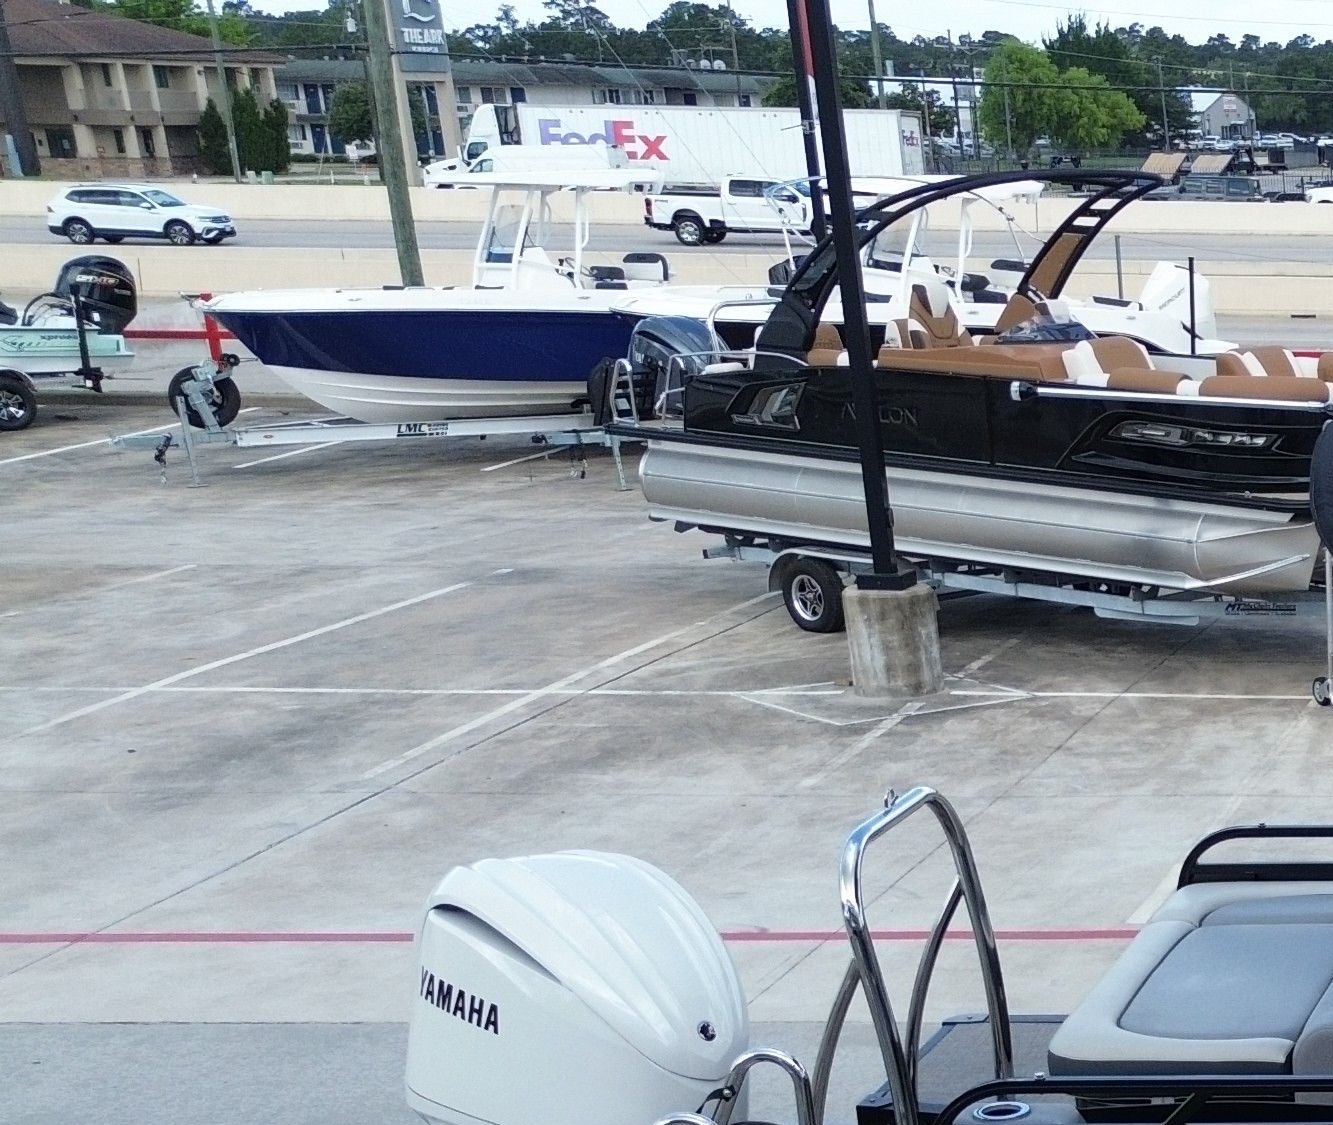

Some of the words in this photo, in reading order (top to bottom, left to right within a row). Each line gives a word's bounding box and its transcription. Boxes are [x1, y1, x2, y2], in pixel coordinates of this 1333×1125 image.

[401, 28, 423, 43] THE
[423, 28, 445, 44] ARK
[841, 402, 919, 427] ALON
[420, 965, 500, 1035] YAMAHA
